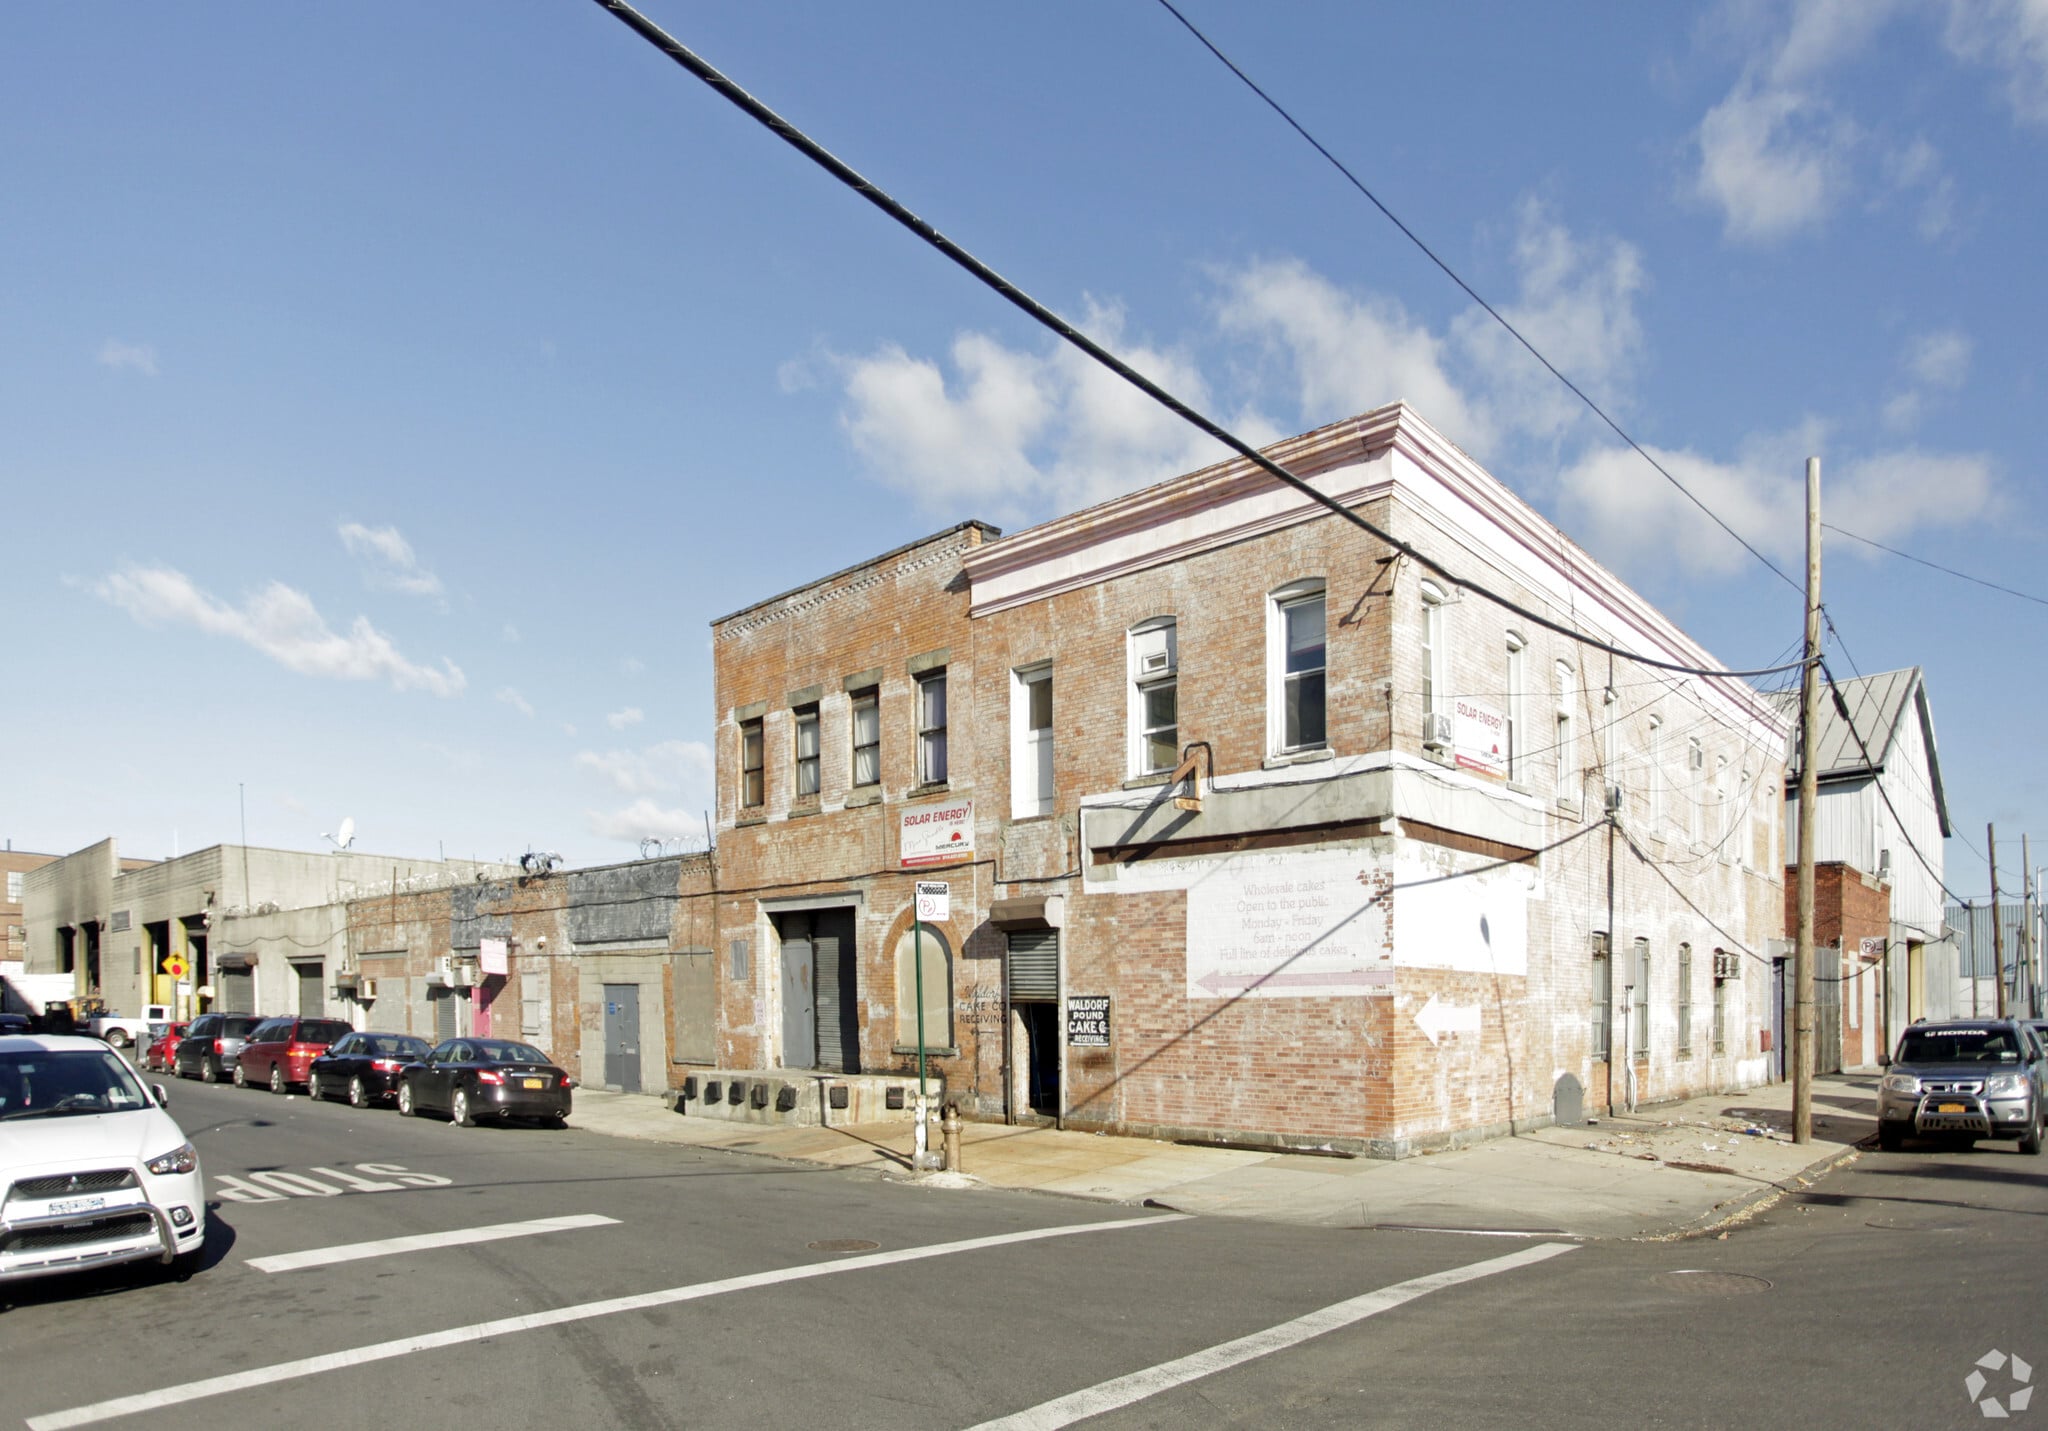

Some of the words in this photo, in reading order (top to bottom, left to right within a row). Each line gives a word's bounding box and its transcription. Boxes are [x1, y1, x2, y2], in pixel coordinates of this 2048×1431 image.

[1457, 702, 1477, 719] SOLAR
[1479, 711, 1502, 730] ENERGY
[904, 813, 930, 827] SOLAR
[933, 807, 968, 822] ENERGY
[1243, 882, 1294, 896] Wholesale
[1297, 880, 1325, 893] cakes
[1237, 901, 1264, 915] Open
[1267, 899, 1277, 910] to
[1280, 896, 1295, 909] the
[1298, 895, 1329, 912] public
[1241, 917, 1282, 931] Monday
[1292, 914, 1324, 928] Friday
[1253, 933, 1275, 944] 6am
[1285, 932, 1312, 942] noon
[1220, 948, 1237, 961] Full
[1240, 947, 1257, 960] line
[1260, 946, 1270, 958] of
[1319, 943, 1348, 955] cakes
[960, 1002, 986, 1011] CAKE
[992, 1001, 1007, 1011] CO
[1068, 999, 1109, 1011] WALDORF
[960, 1015, 1007, 1024] RECEIVING
[1073, 1011, 1104, 1020] POUND
[1069, 1021, 1097, 1033] CAKE
[1074, 1034, 1105, 1042] RECEIVING
[213, 1163, 453, 1203] STOP
